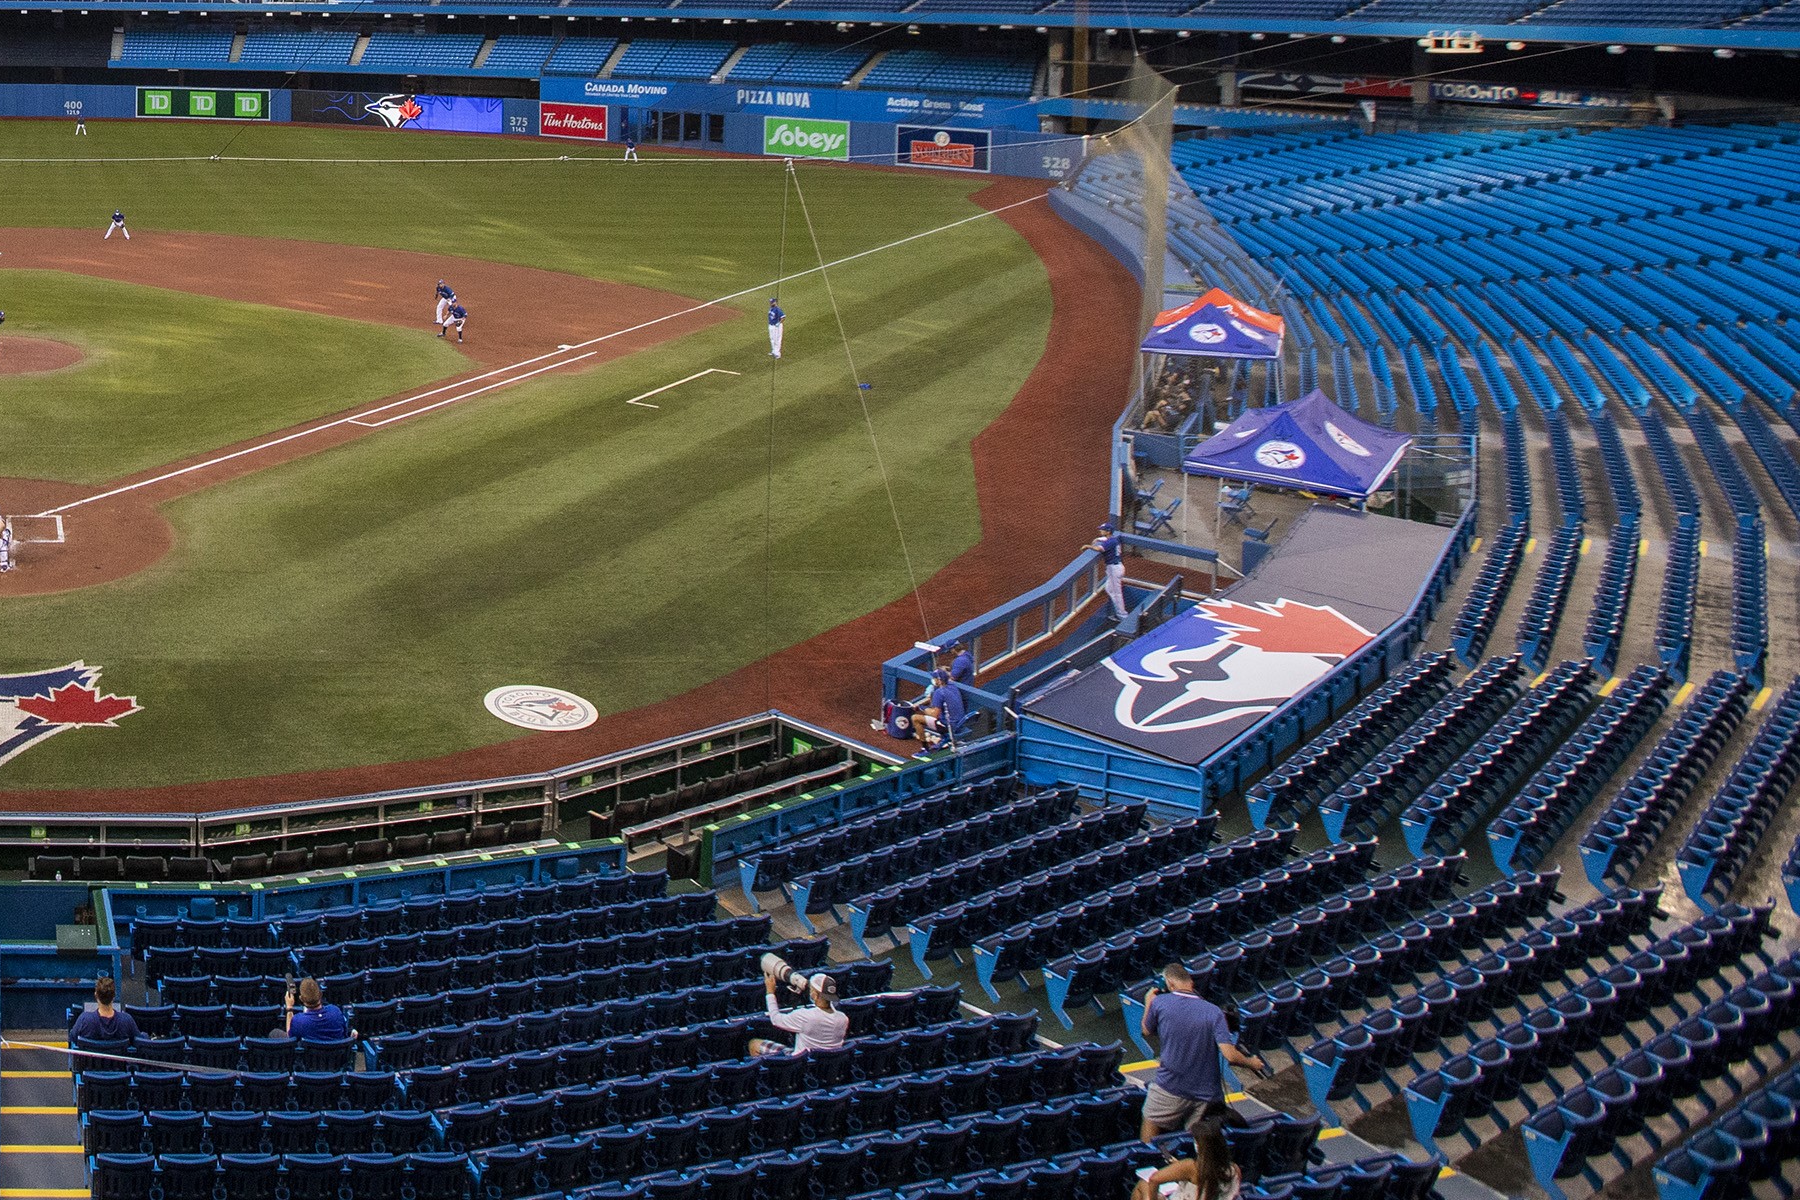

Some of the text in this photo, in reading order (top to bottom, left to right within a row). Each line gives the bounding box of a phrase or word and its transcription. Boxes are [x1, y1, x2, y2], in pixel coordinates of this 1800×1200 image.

[737, 89, 811, 108] PIZZA NOVA
[1431, 83, 1519, 100] TORONTO
[63, 101, 83, 110] 400
[148, 94, 169, 110] TD
[192, 95, 213, 111] TD
[238, 97, 259, 112] TD
[887, 97, 920, 108] Active
[922, 99, 951, 109] Green
[509, 117, 528, 126] 375
[543, 113, 603, 131] Tim Hortons
[768, 123, 845, 152] Sobeys
[1042, 156, 1071, 169] 328
[501, 691, 552, 704] TORONTO
[557, 711, 582, 725] JAYS
